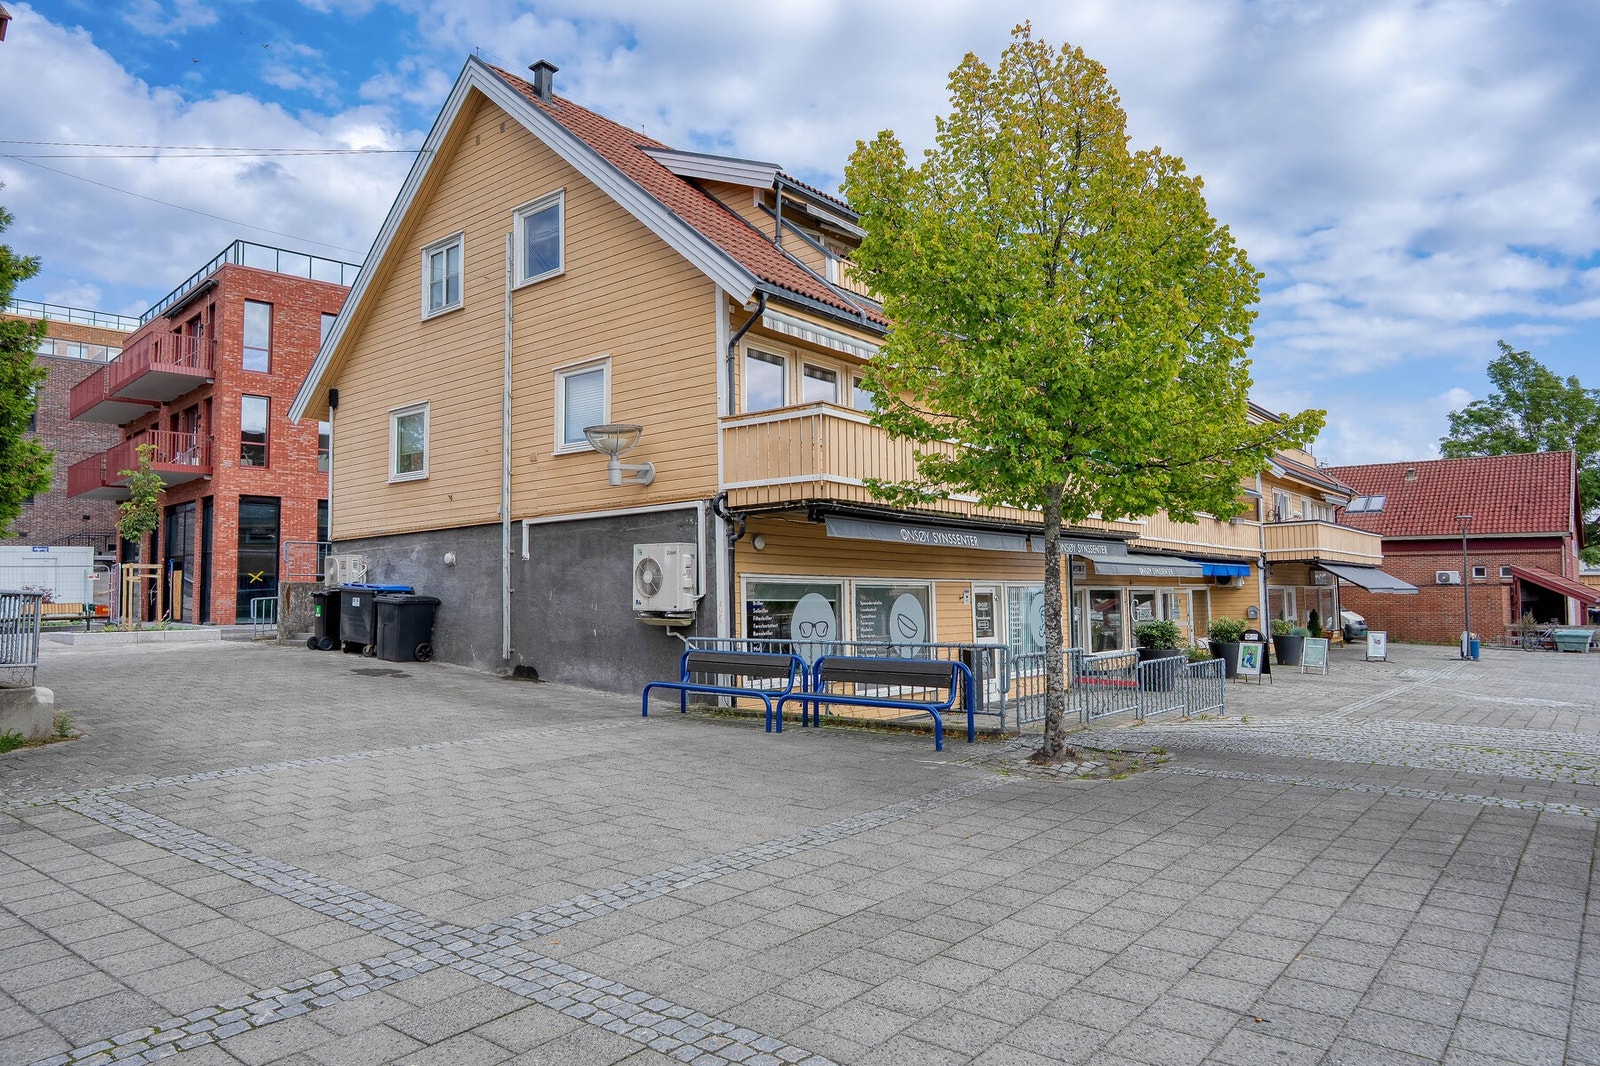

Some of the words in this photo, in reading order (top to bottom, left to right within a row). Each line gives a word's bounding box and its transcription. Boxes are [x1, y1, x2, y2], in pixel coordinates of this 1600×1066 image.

[900, 528, 930, 542] ONSØY
[932, 531, 979, 546] SYNSSENTER
[1078, 543, 1107, 554] SYNSSENTER
